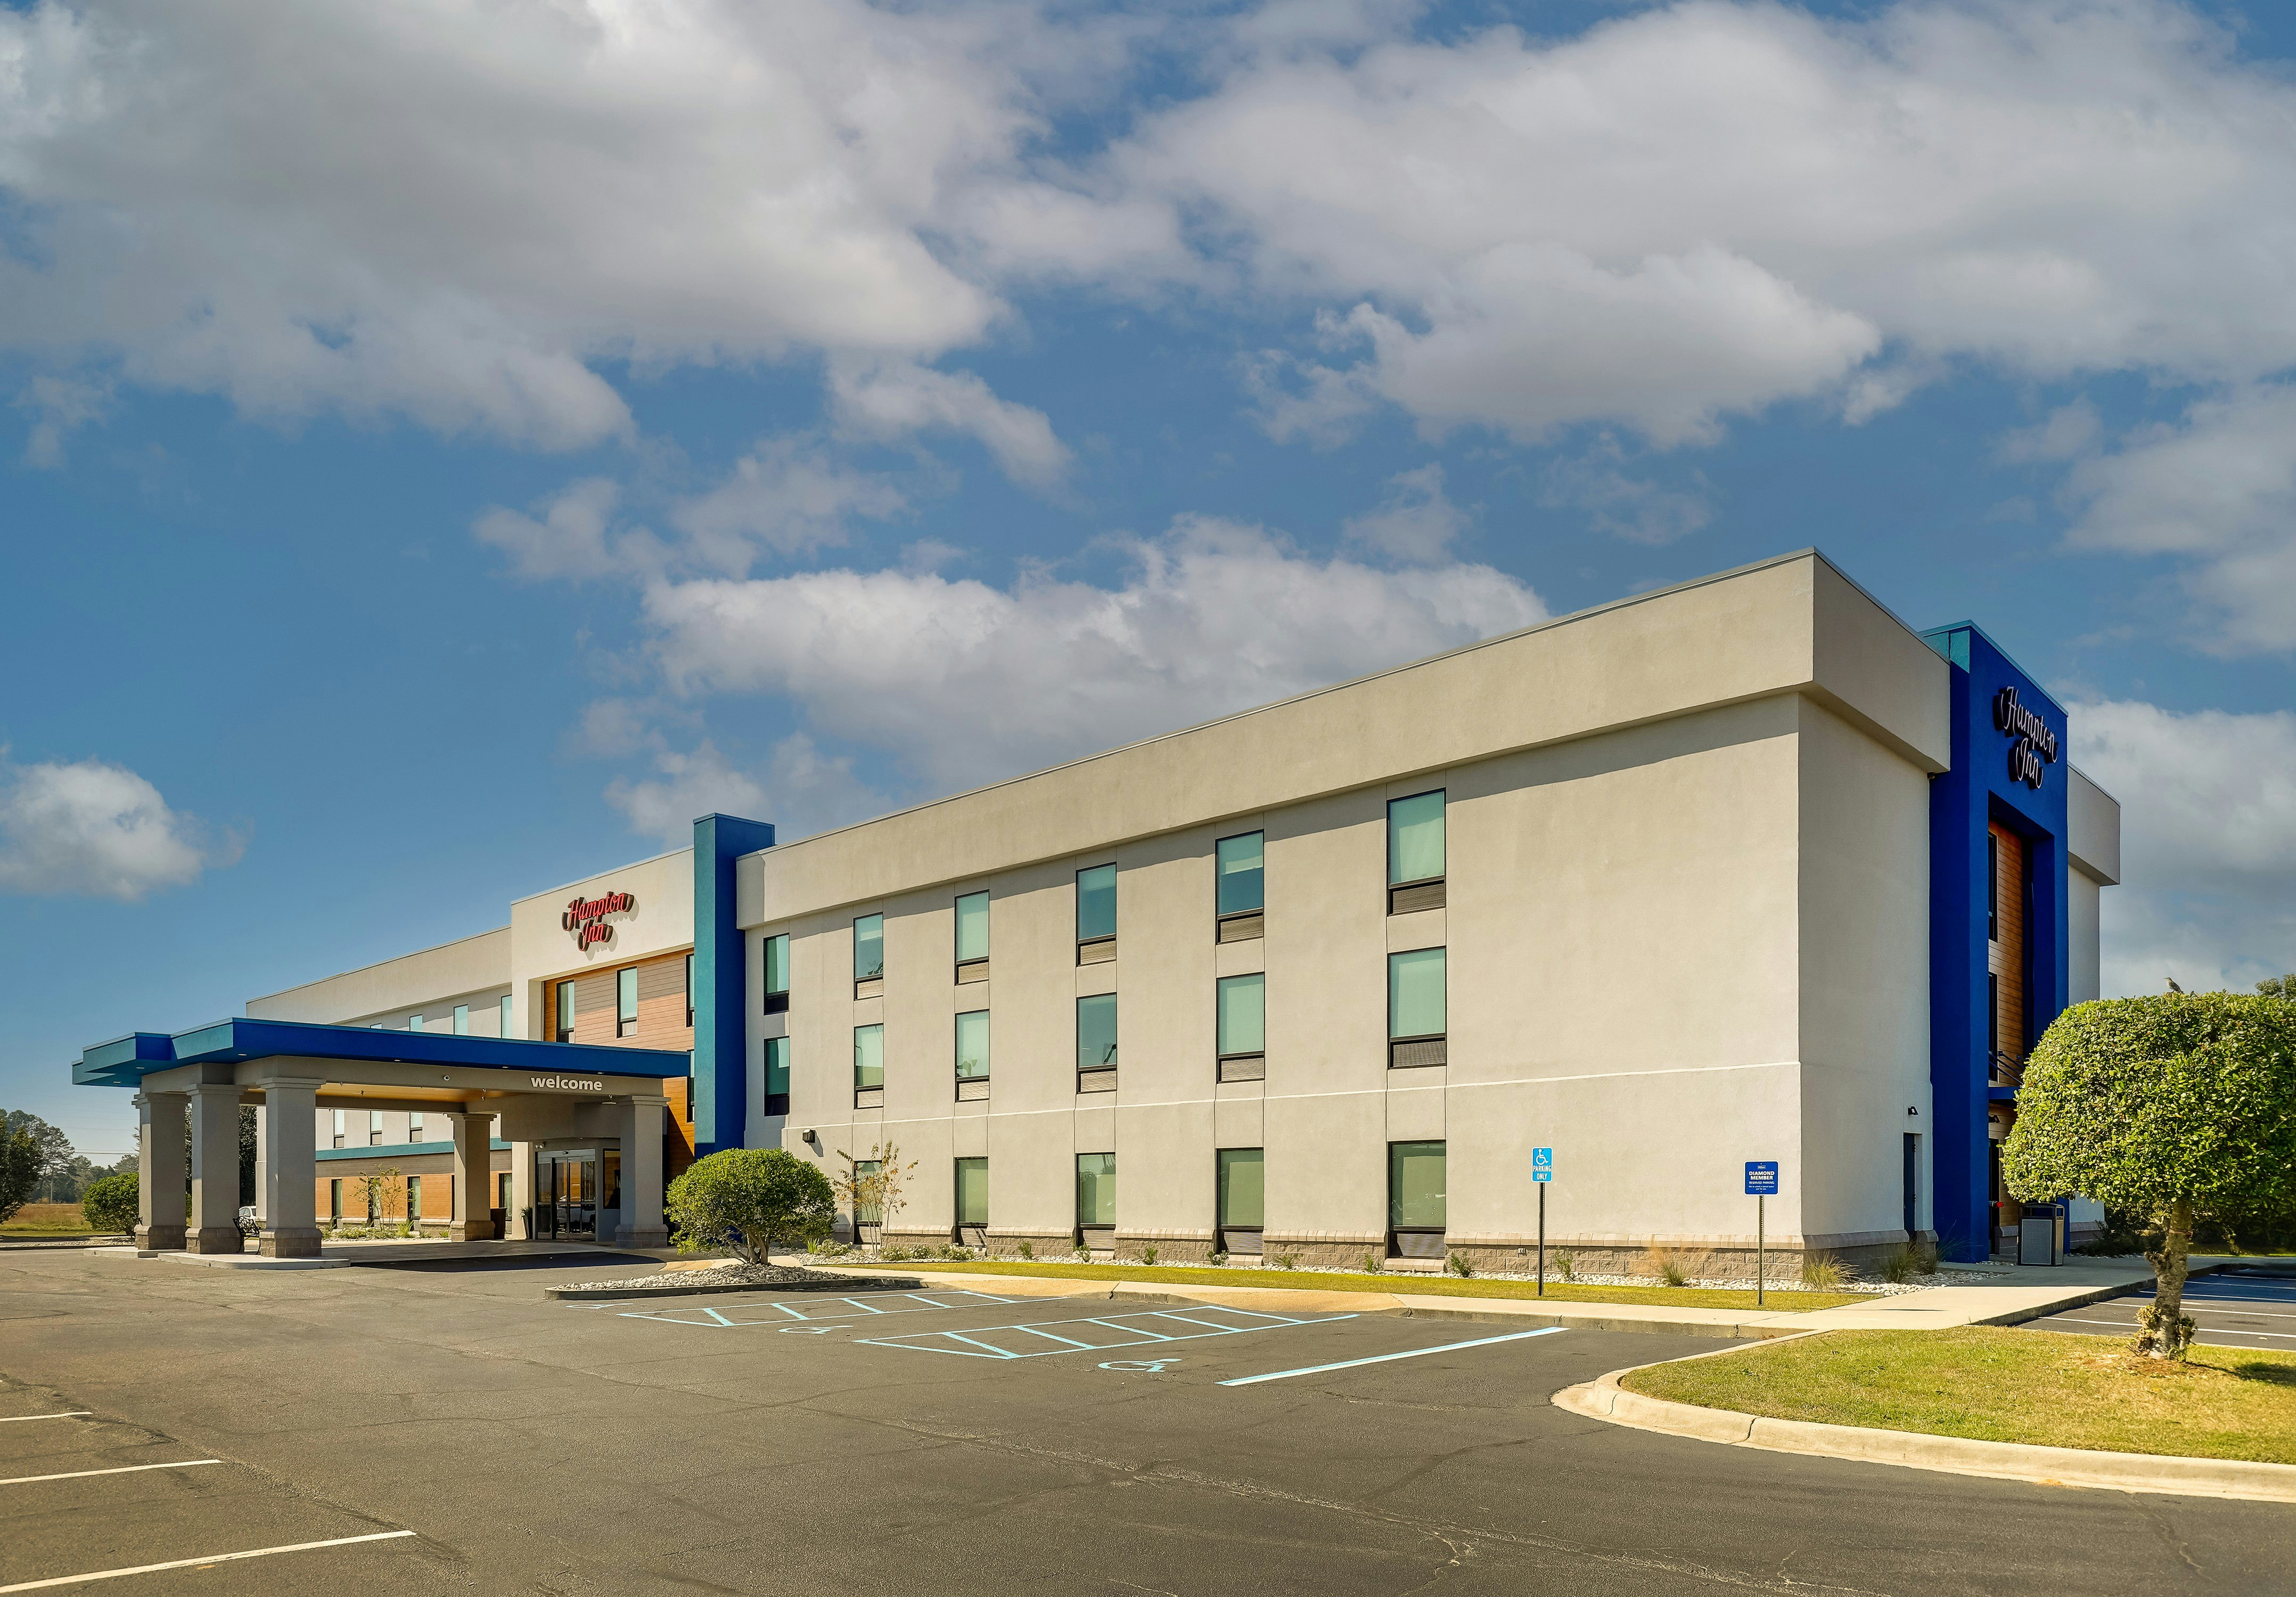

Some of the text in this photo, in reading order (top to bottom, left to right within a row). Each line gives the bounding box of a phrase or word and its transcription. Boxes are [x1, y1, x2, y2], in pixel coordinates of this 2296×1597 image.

[2000, 686, 2059, 763] Hampton
[2015, 737, 2044, 789] Inn
[562, 891, 634, 932] Hampton
[578, 919, 613, 951] Inn
[531, 1075, 603, 1091] welcome
